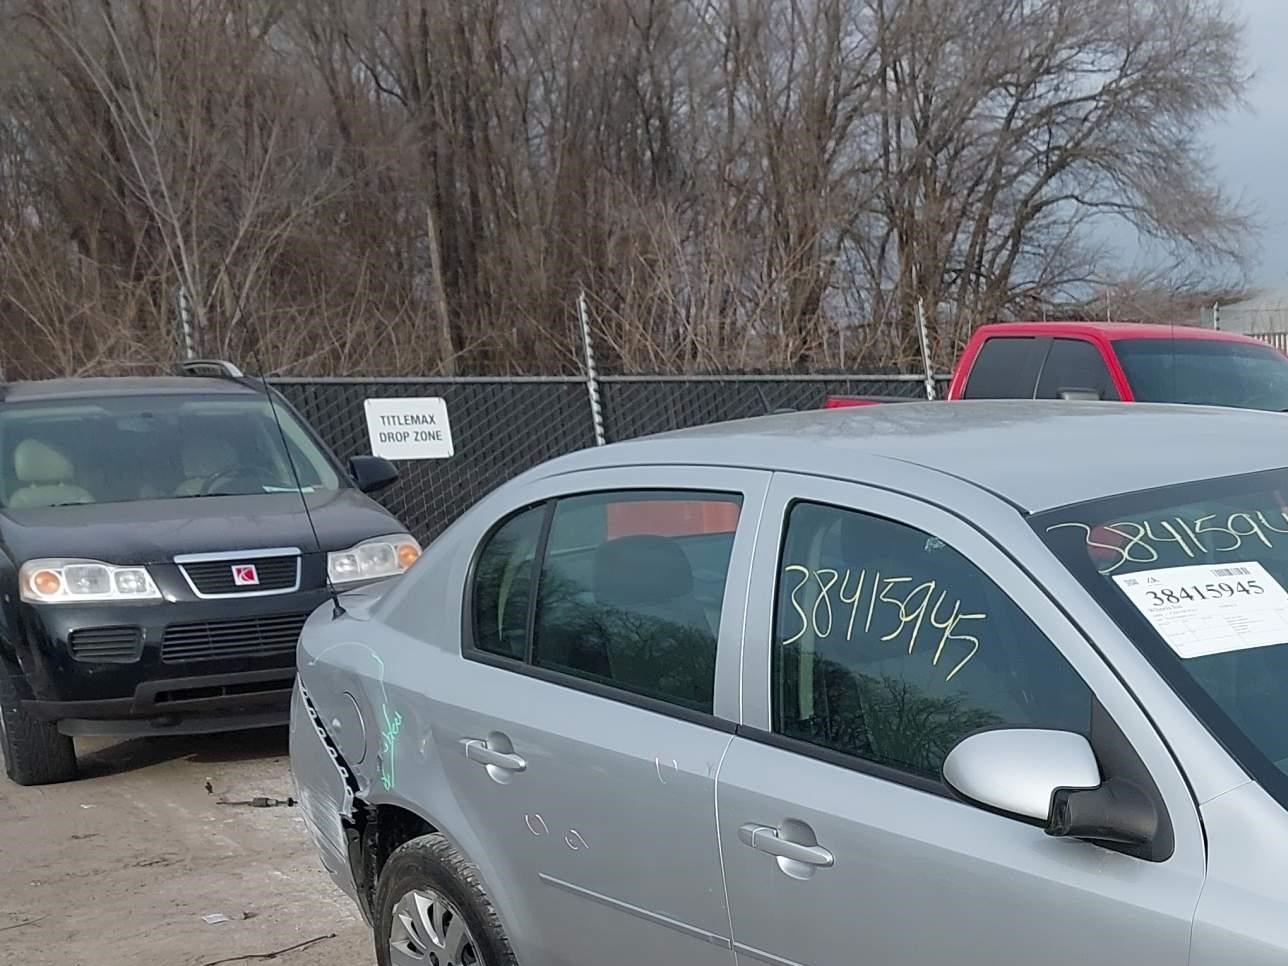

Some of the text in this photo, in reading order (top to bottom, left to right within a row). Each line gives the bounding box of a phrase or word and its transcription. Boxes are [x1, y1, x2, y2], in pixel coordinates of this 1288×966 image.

[379, 414, 437, 426] TITLEMAX
[379, 430, 443, 443] DROP ZONE
[1145, 580, 1265, 607] 38415945
[782, 564, 987, 681] 38415945
